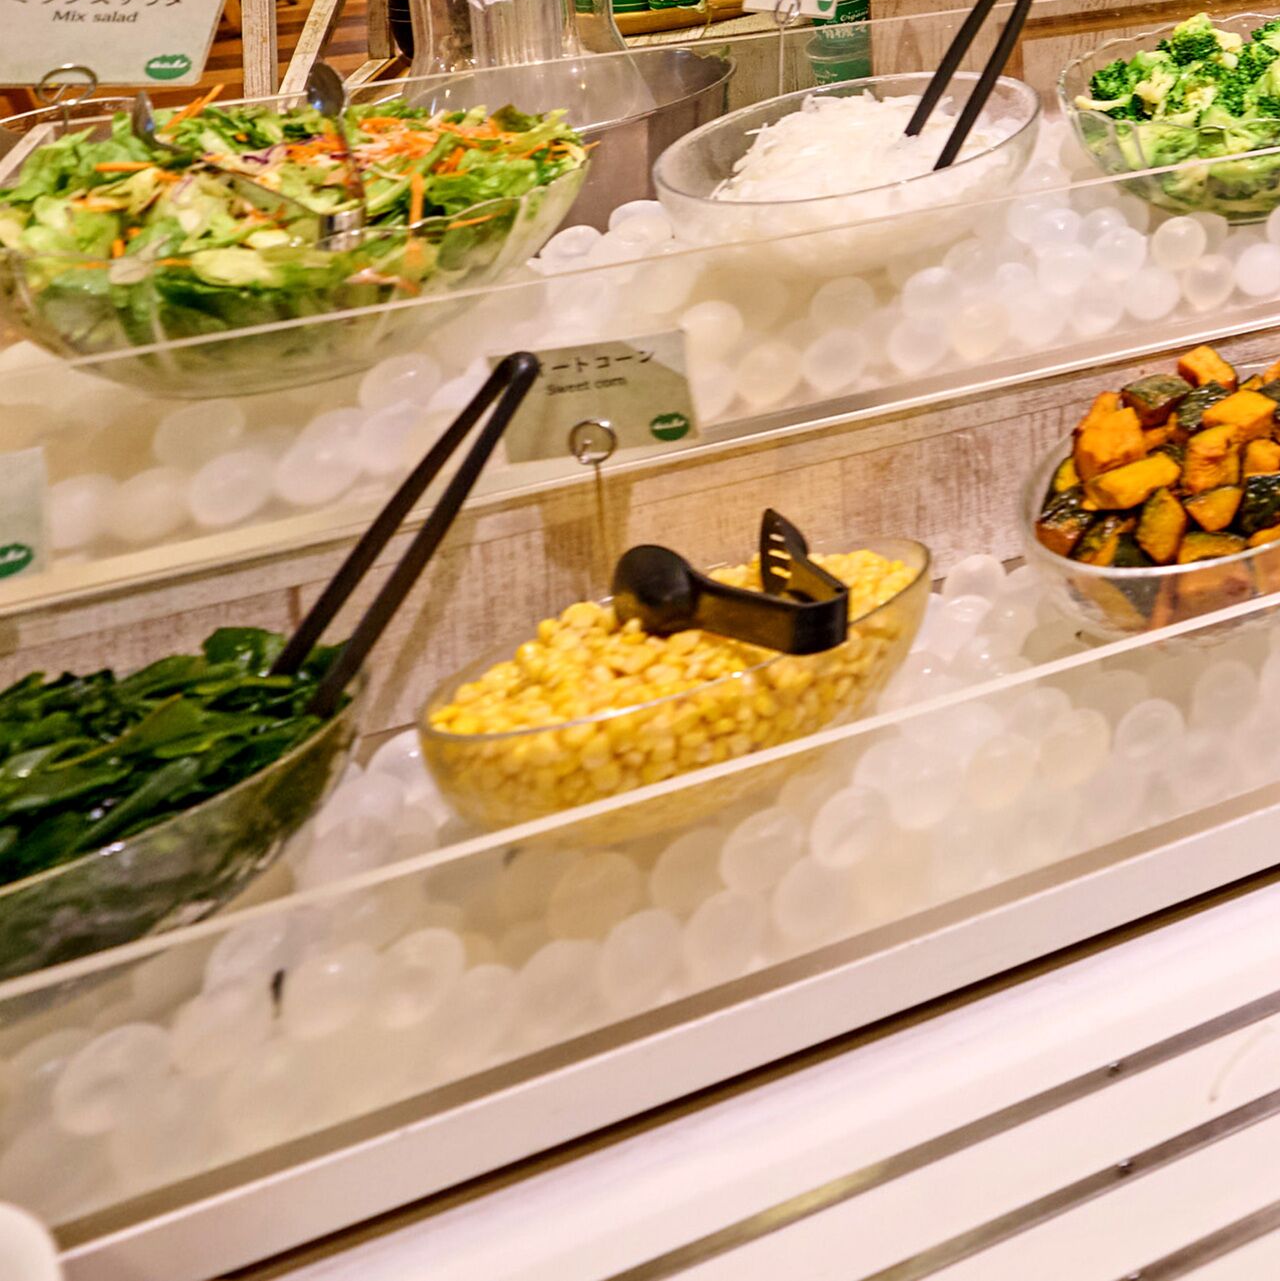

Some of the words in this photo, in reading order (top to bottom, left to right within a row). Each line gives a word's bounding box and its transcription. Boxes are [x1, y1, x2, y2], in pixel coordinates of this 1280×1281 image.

[52, 10, 86, 23] Mix
[92, 11, 139, 24] salad
[539, 351, 654, 377] ートコーン
